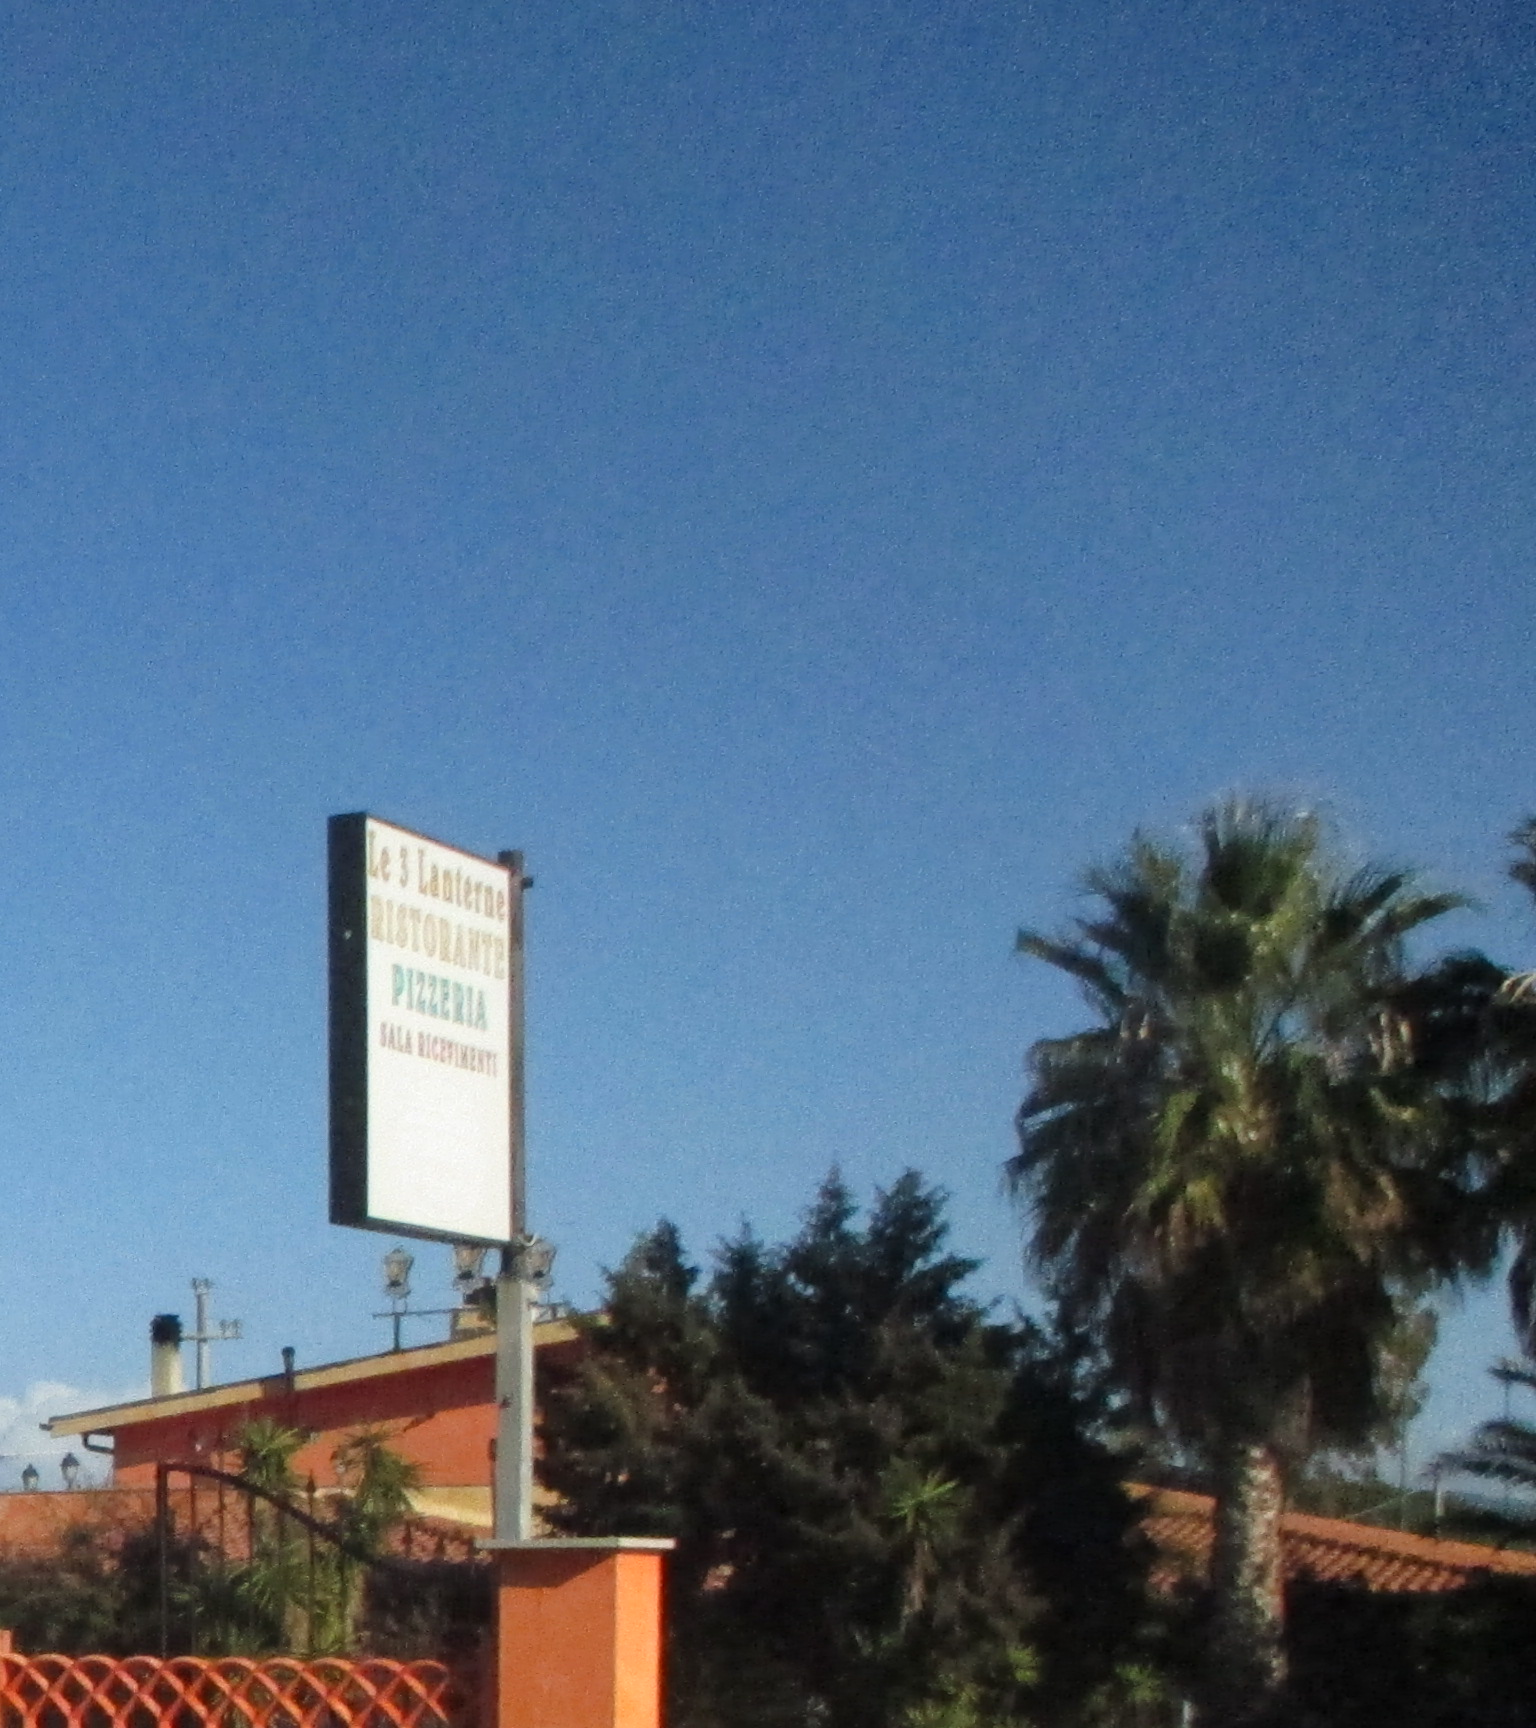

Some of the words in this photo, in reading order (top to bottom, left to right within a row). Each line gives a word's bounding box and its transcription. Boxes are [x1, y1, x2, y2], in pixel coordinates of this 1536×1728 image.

[368, 830, 390, 882] Le
[399, 845, 410, 888] 3
[418, 848, 505, 923] Lanterne
[371, 895, 505, 980] RISTORANTE
[392, 963, 488, 1032] PIZZERIA
[380, 1021, 412, 1055] SALA
[418, 1031, 498, 1078] RICEVIMENTI
